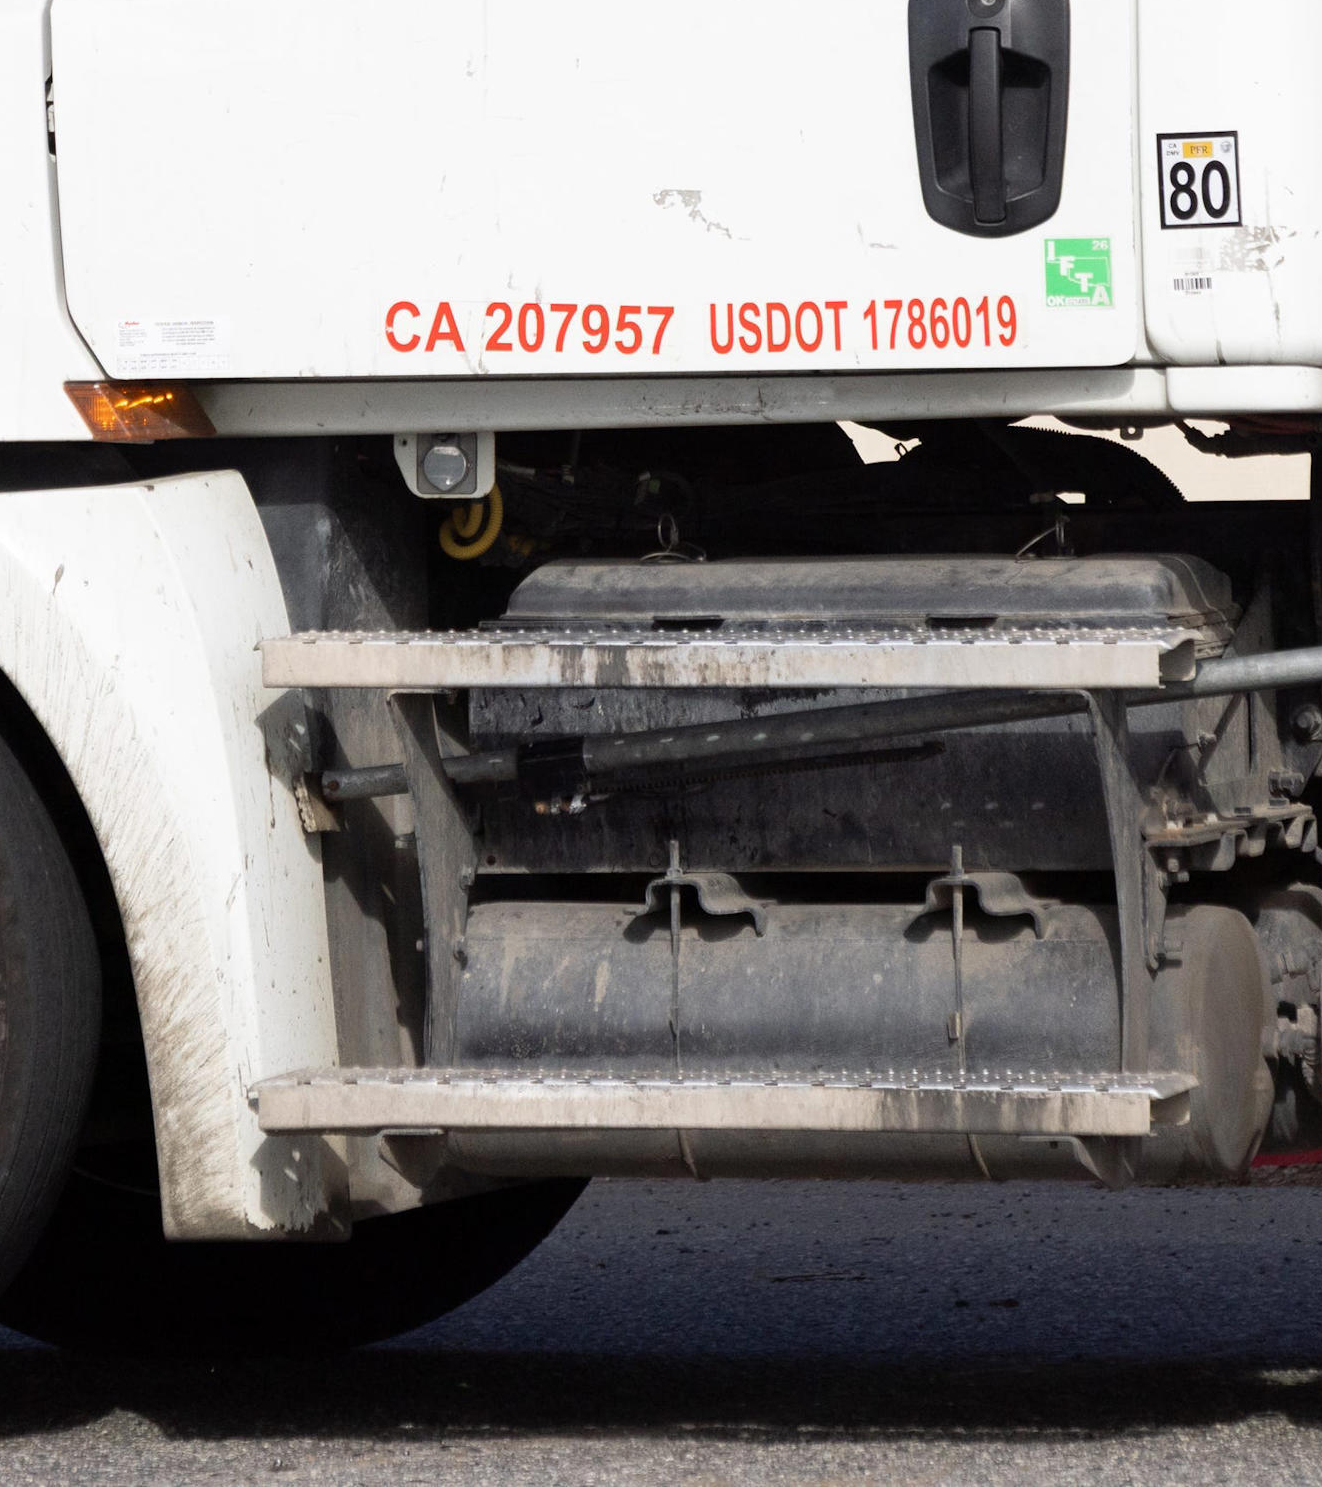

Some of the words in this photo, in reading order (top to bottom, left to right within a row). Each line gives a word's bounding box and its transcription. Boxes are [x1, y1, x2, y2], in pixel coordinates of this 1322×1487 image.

[1190, 145, 1209, 154] PFR
[1169, 160, 1231, 221] 80
[385, 301, 466, 353] CA
[485, 301, 675, 355] 207957
[709, 300, 849, 355] USDOT
[863, 294, 1018, 351] 1786019
